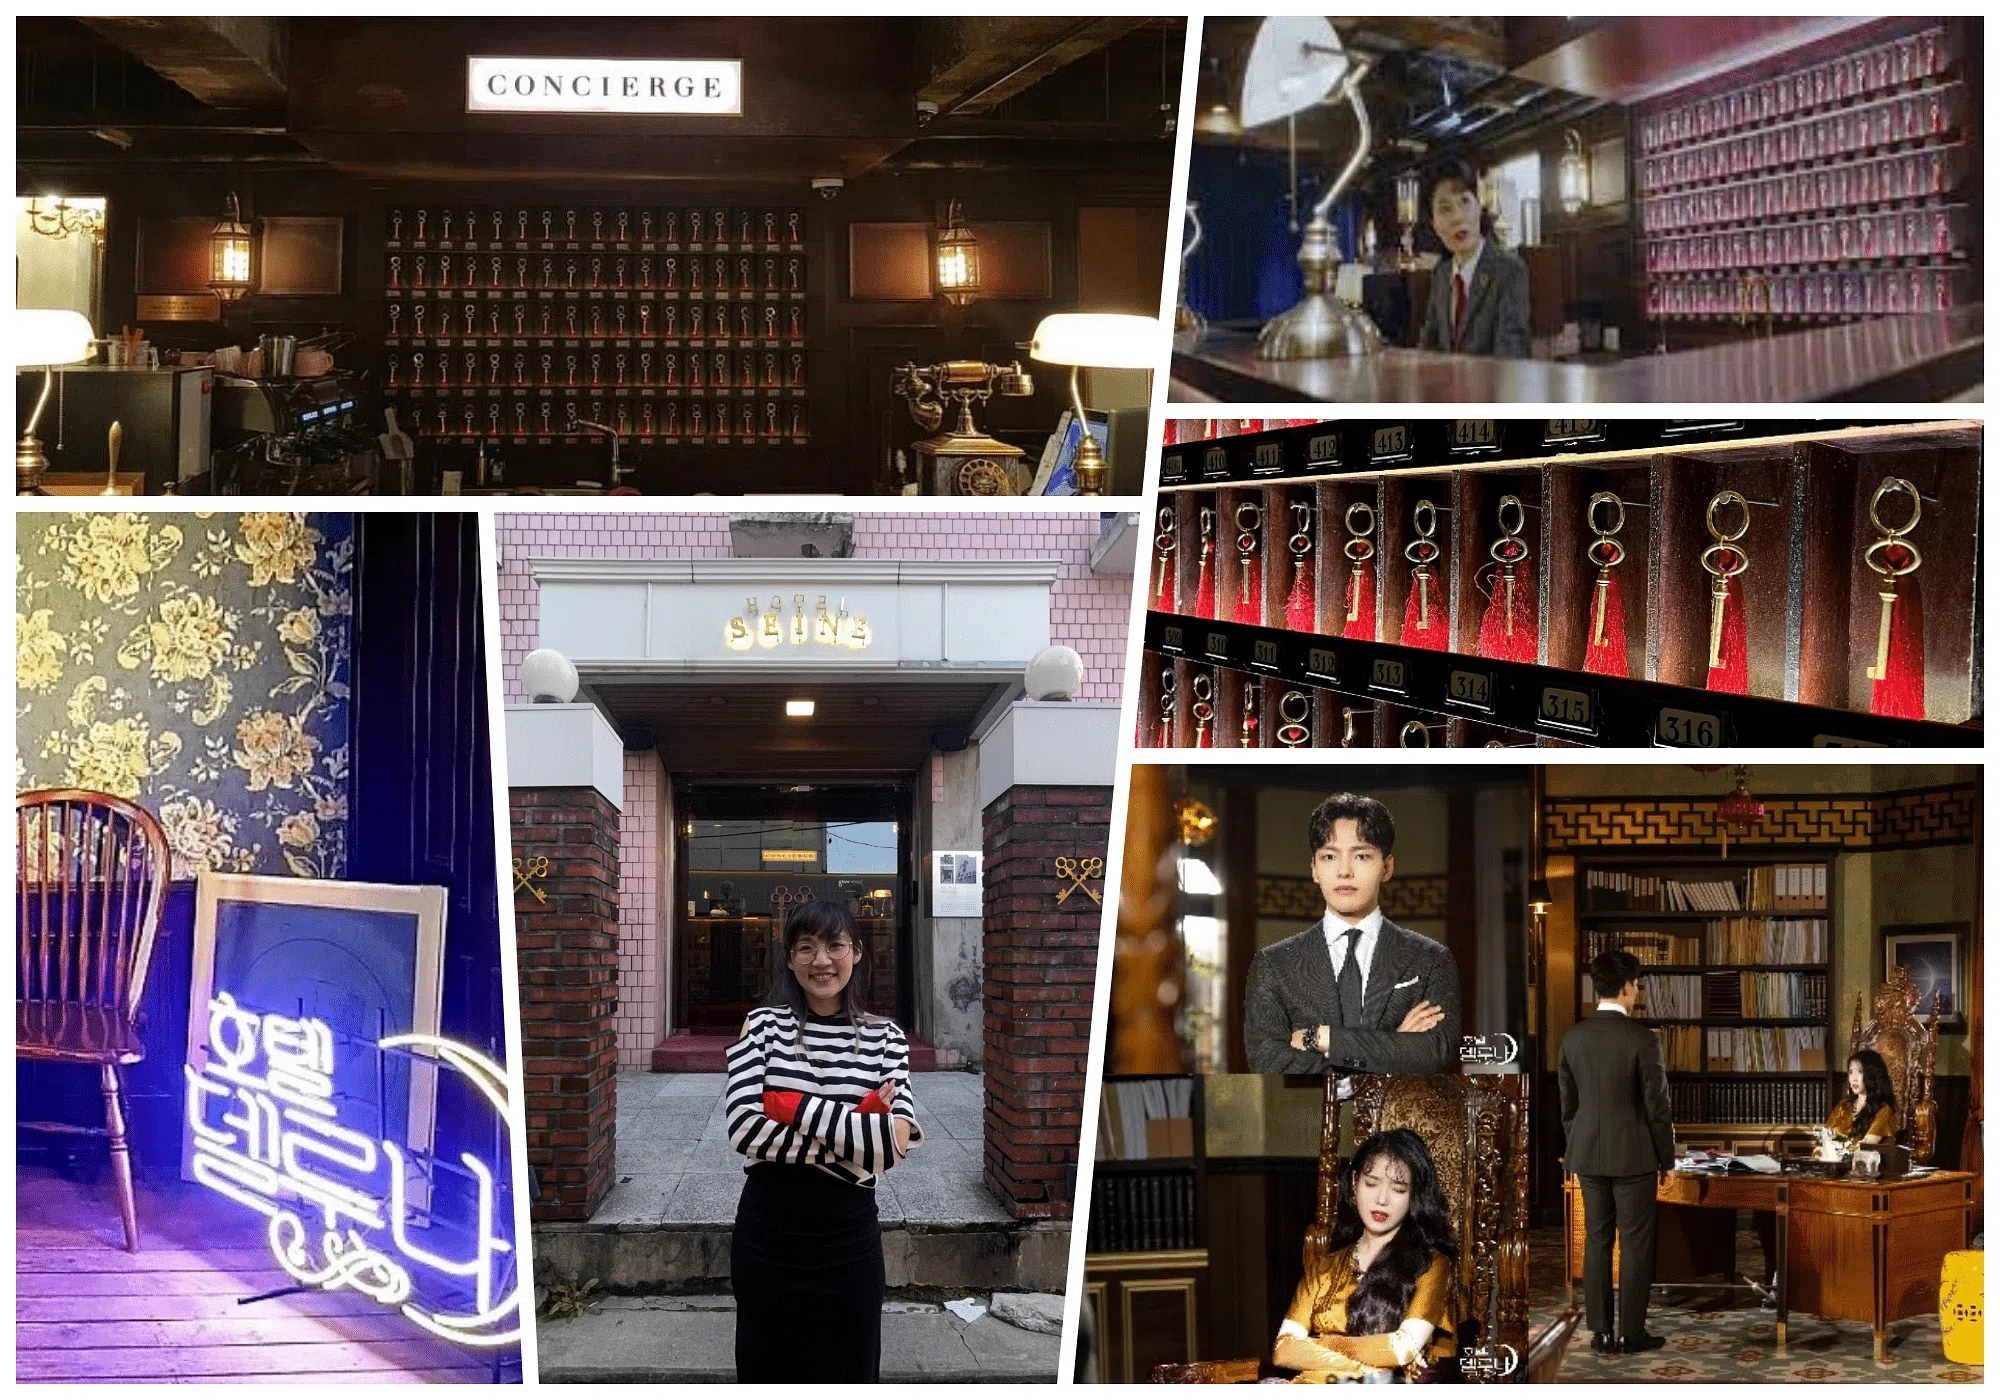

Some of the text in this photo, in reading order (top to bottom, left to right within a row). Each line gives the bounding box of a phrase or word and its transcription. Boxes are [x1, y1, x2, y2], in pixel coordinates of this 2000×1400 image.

[487, 73, 722, 99] CONCIERGE
[1376, 431, 1405, 453] 413
[1457, 421, 1491, 443] 414
[1257, 447, 1277, 465] 411
[1313, 439, 1337, 459] 412
[1208, 453, 1224, 470] 410
[745, 593, 850, 617] HOTEL
[730, 612, 868, 640] SEINE
[1210, 636, 1227, 654] 310
[1256, 643, 1276, 663] 311
[1312, 652, 1336, 673] 312
[1376, 663, 1401, 684] 313
[1456, 675, 1488, 701] 314
[1546, 693, 1586, 723] 315
[1665, 716, 1714, 747] 316
[206, 990, 338, 1117] 호텔
[184, 1062, 513, 1315] 델루나
